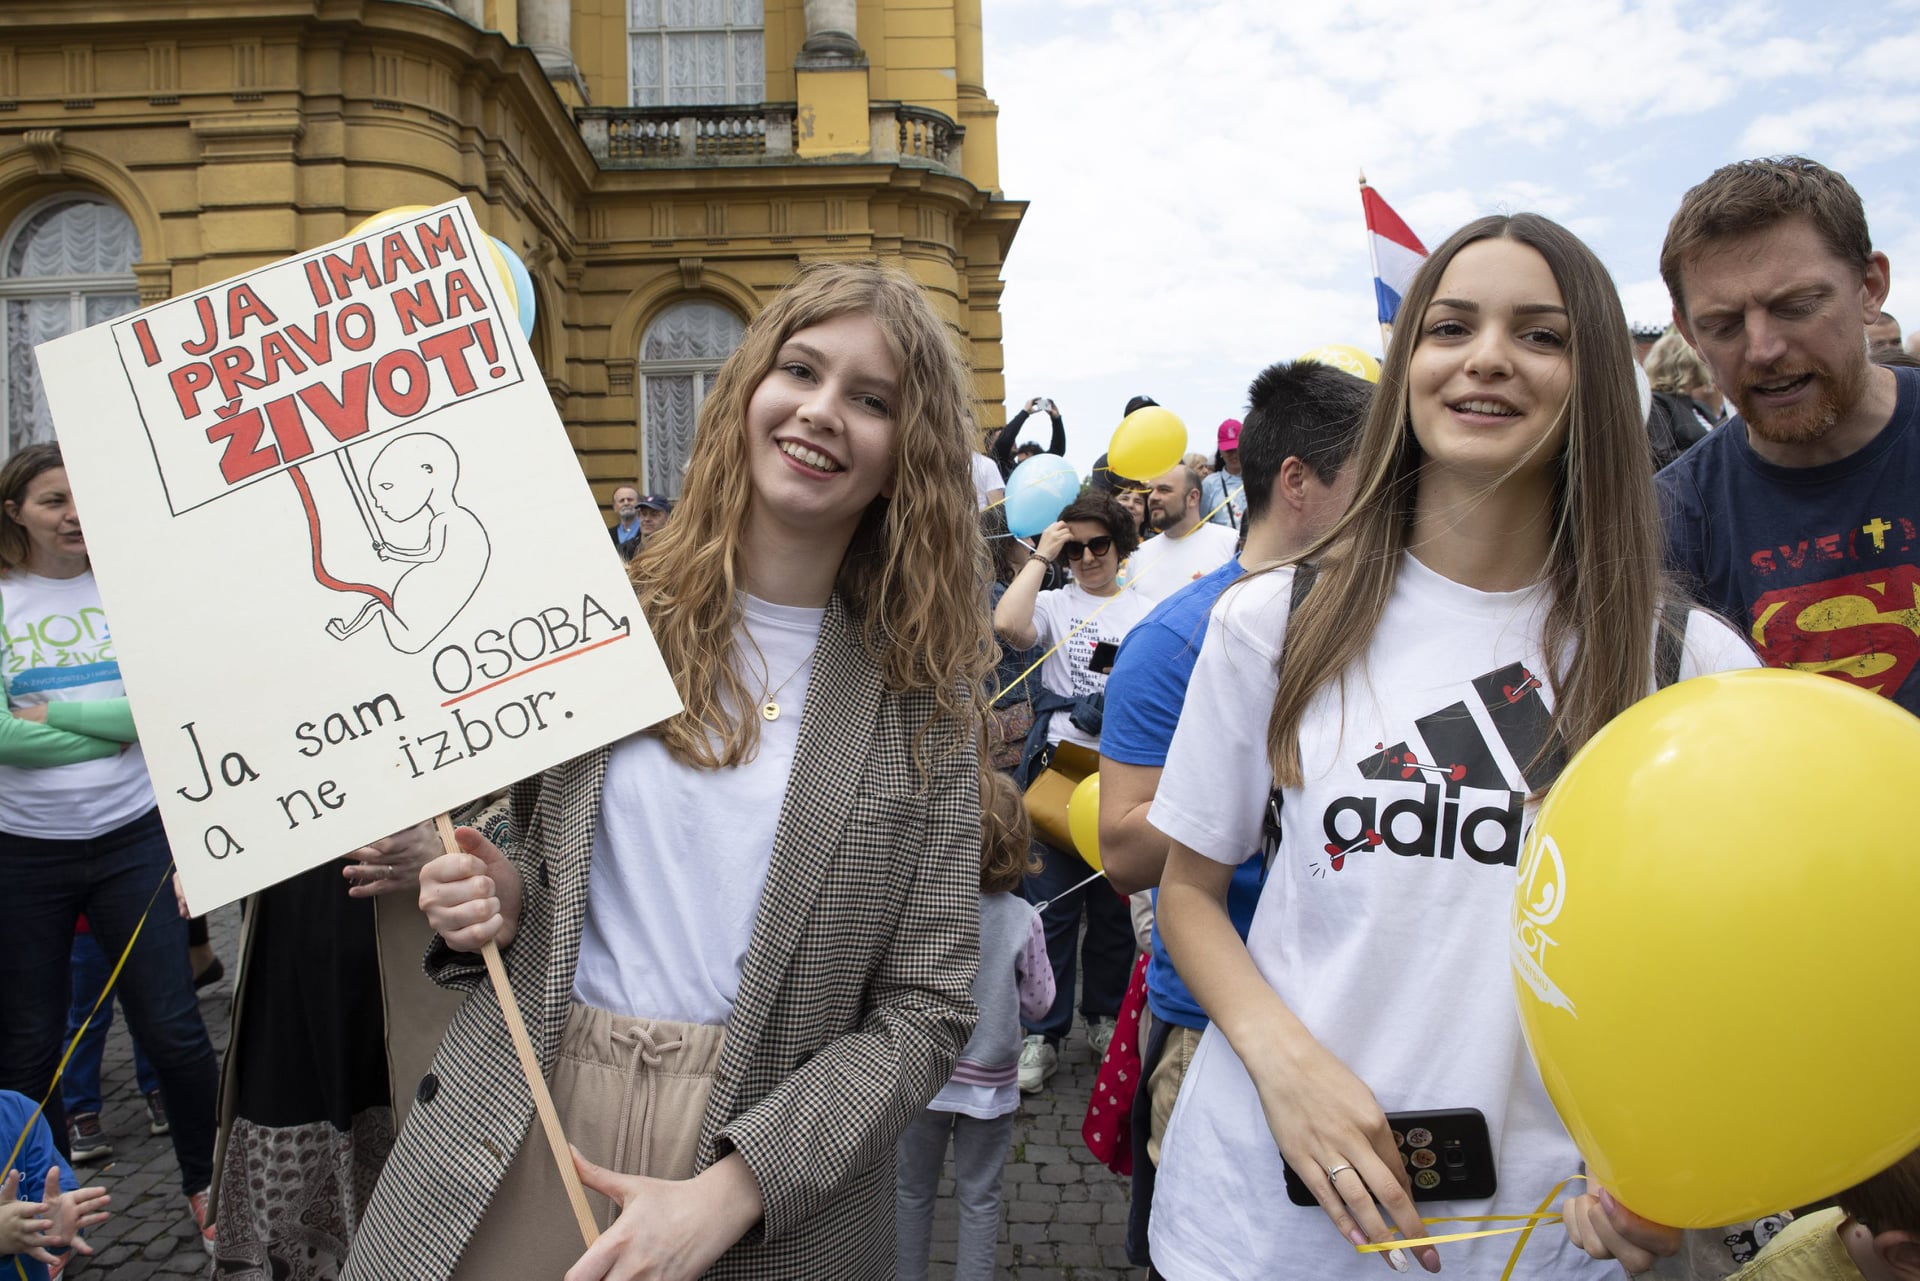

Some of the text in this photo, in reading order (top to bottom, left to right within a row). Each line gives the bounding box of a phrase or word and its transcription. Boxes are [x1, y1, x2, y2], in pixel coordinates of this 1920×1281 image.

[132, 214, 467, 367] I JA IMAM
[168, 269, 487, 420] PRAVO NA
[205, 318, 508, 485] ŽIVOT!
[177, 594, 631, 803] Ja sam OSOBA,
[203, 688, 575, 861] a ne izbor.
